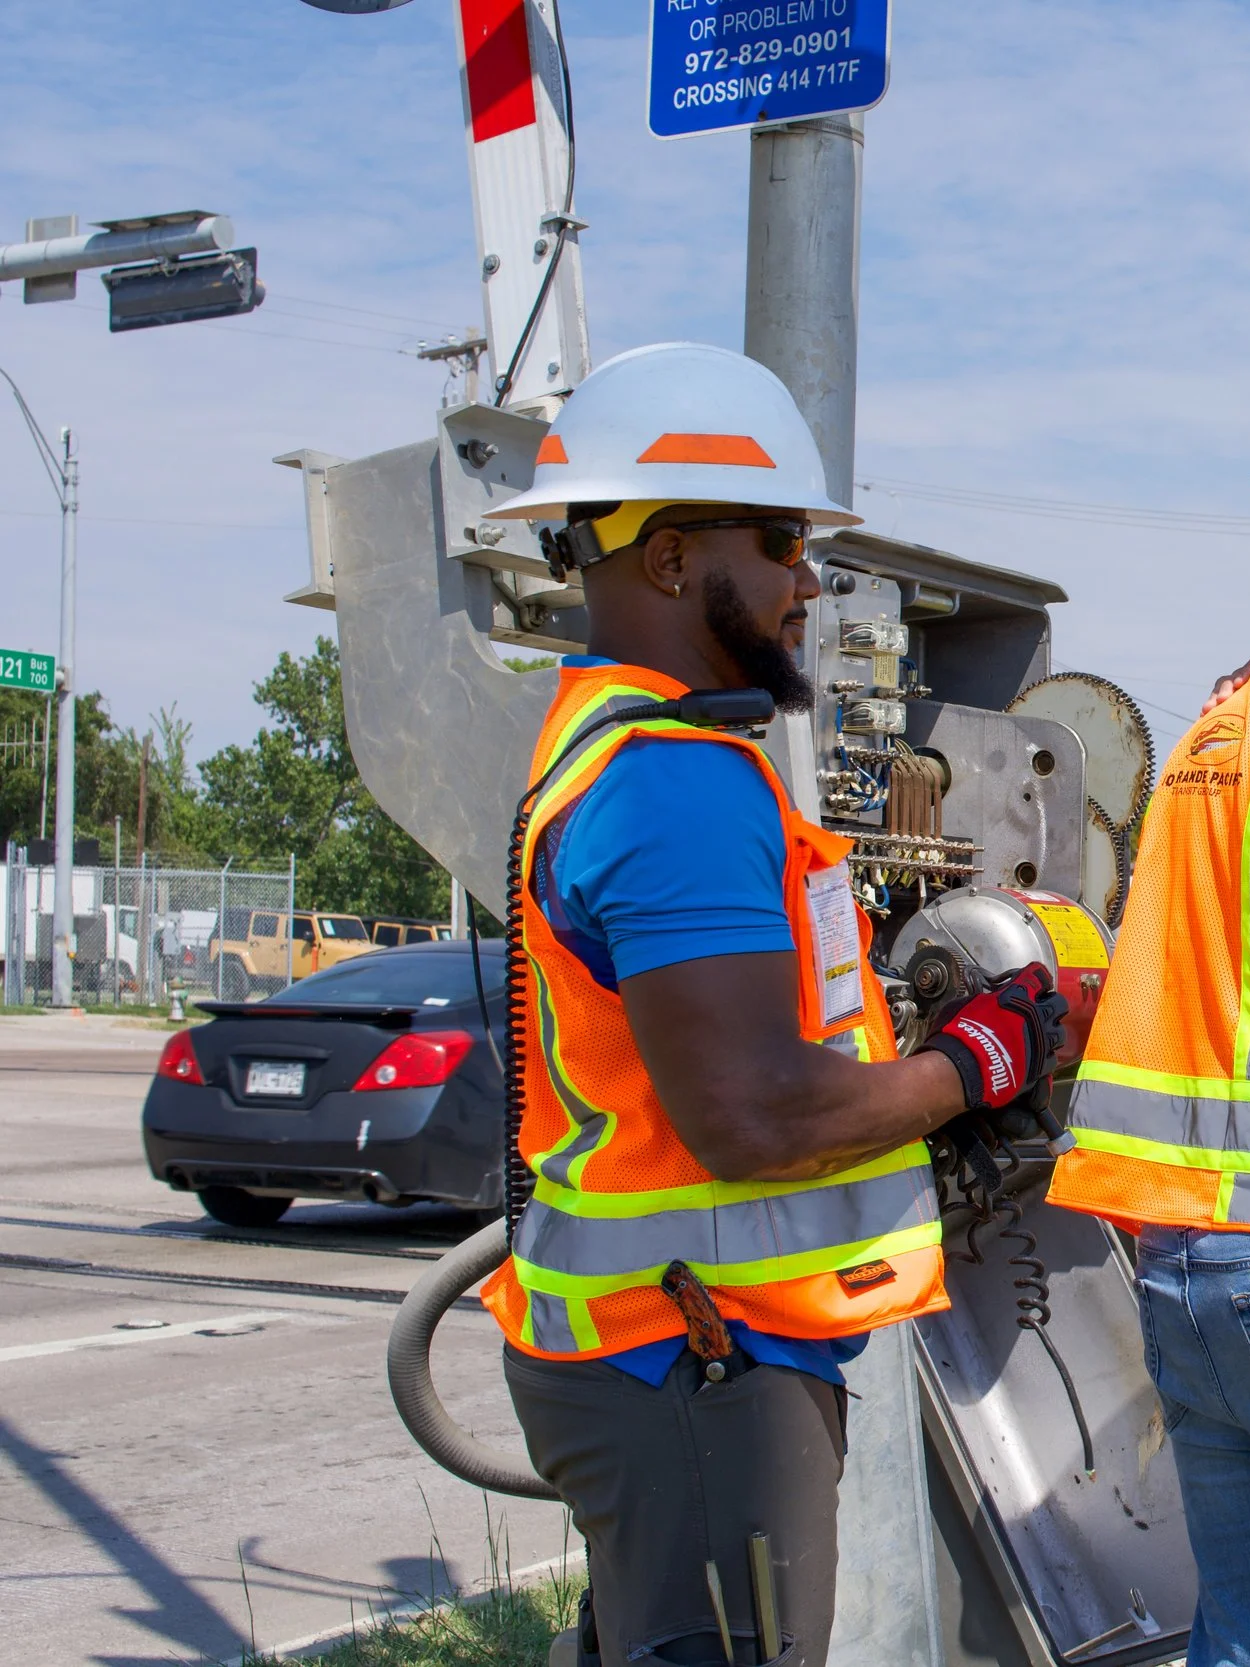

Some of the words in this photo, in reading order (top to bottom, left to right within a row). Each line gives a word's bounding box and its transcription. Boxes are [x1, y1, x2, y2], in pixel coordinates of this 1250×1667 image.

[689, 17, 716, 40] OR
[723, 0, 815, 35] PROBLEM
[685, 26, 851, 75] 972-829-0901
[673, 73, 773, 109] CROSSING
[777, 67, 810, 92] 414
[816, 59, 860, 87] 717F
[30, 657, 48, 671] Bus
[30, 672, 48, 685] 700
[957, 1021, 1010, 1096] Milwaukee
